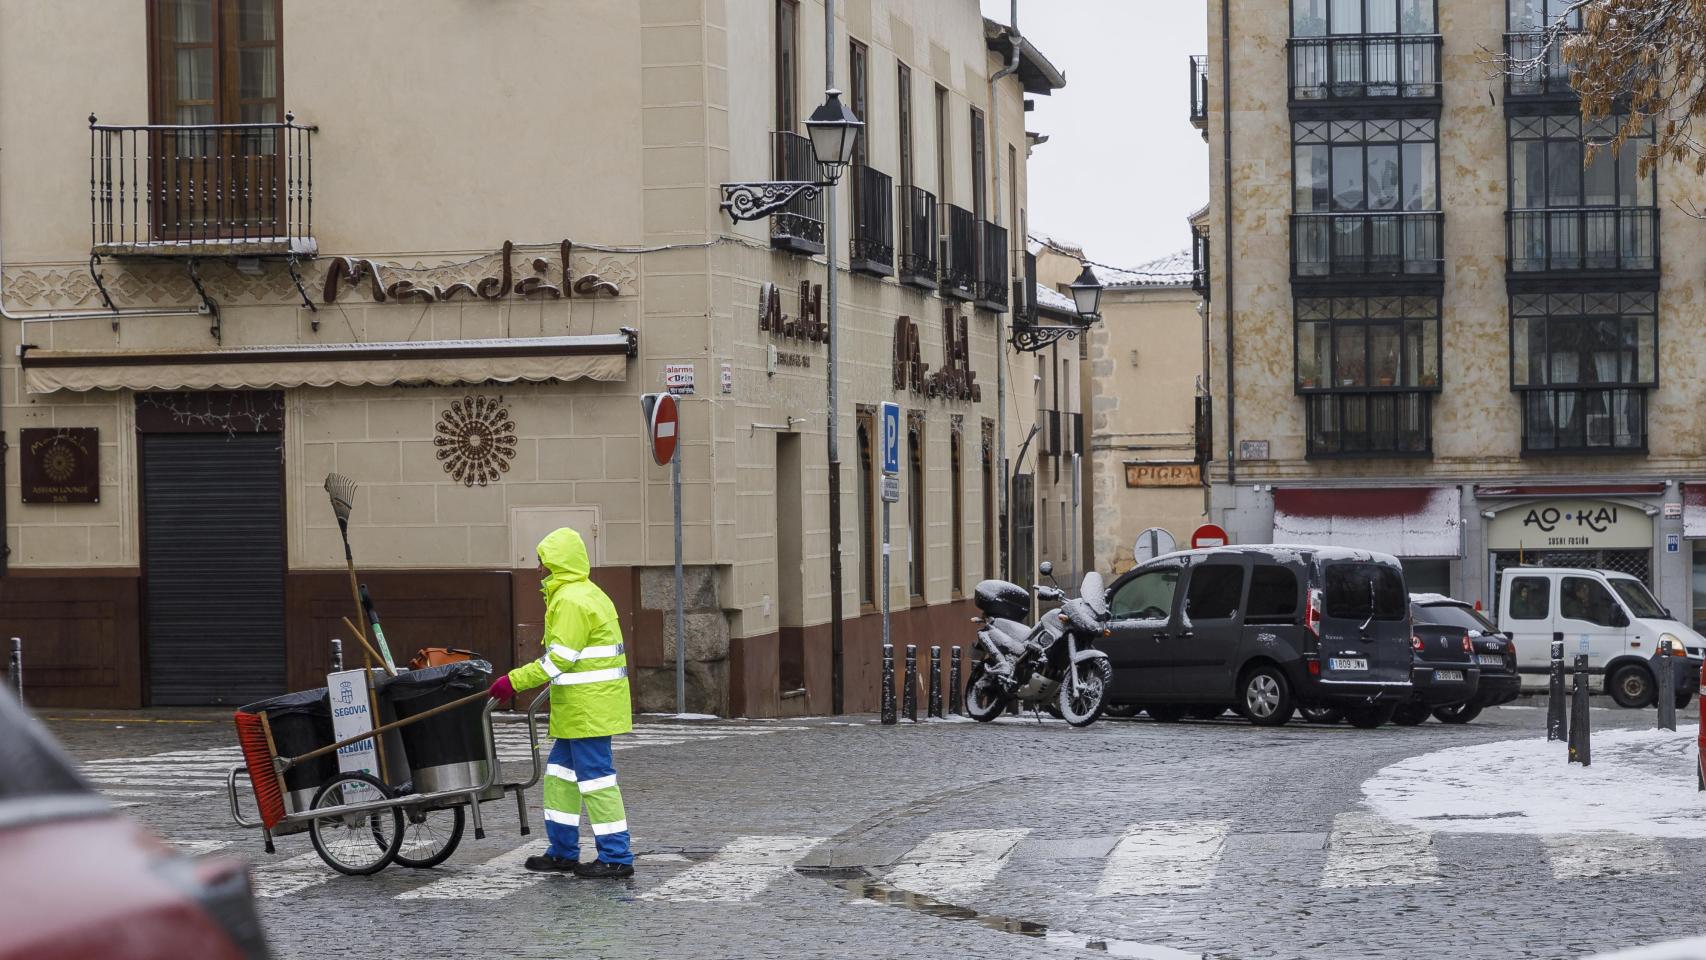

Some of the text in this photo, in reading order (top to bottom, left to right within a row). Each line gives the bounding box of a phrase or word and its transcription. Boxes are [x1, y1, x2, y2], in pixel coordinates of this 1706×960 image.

[323, 239, 620, 303] Mandala
[1334, 659, 1351, 669] 1809
[334, 704, 368, 718] SEGOVIA
